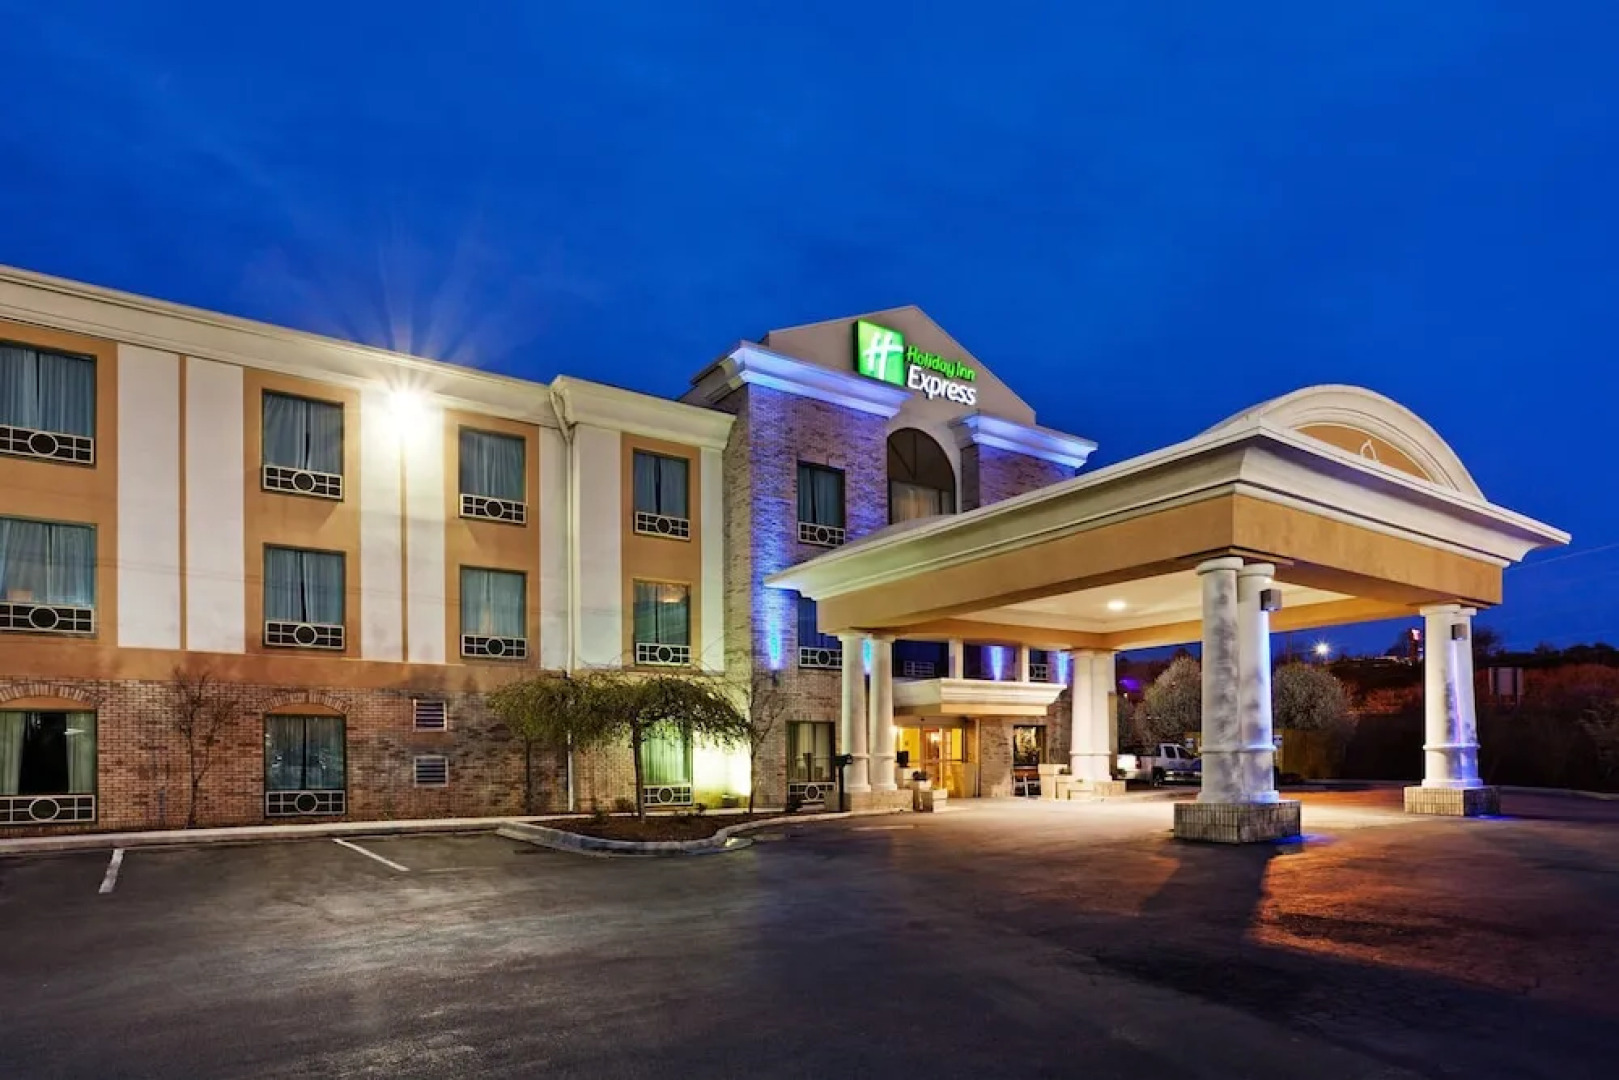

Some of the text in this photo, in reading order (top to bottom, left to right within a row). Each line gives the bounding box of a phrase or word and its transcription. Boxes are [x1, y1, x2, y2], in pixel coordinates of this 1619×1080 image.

[907, 345, 976, 381] Holiday Inn
[907, 363, 977, 405] Express
